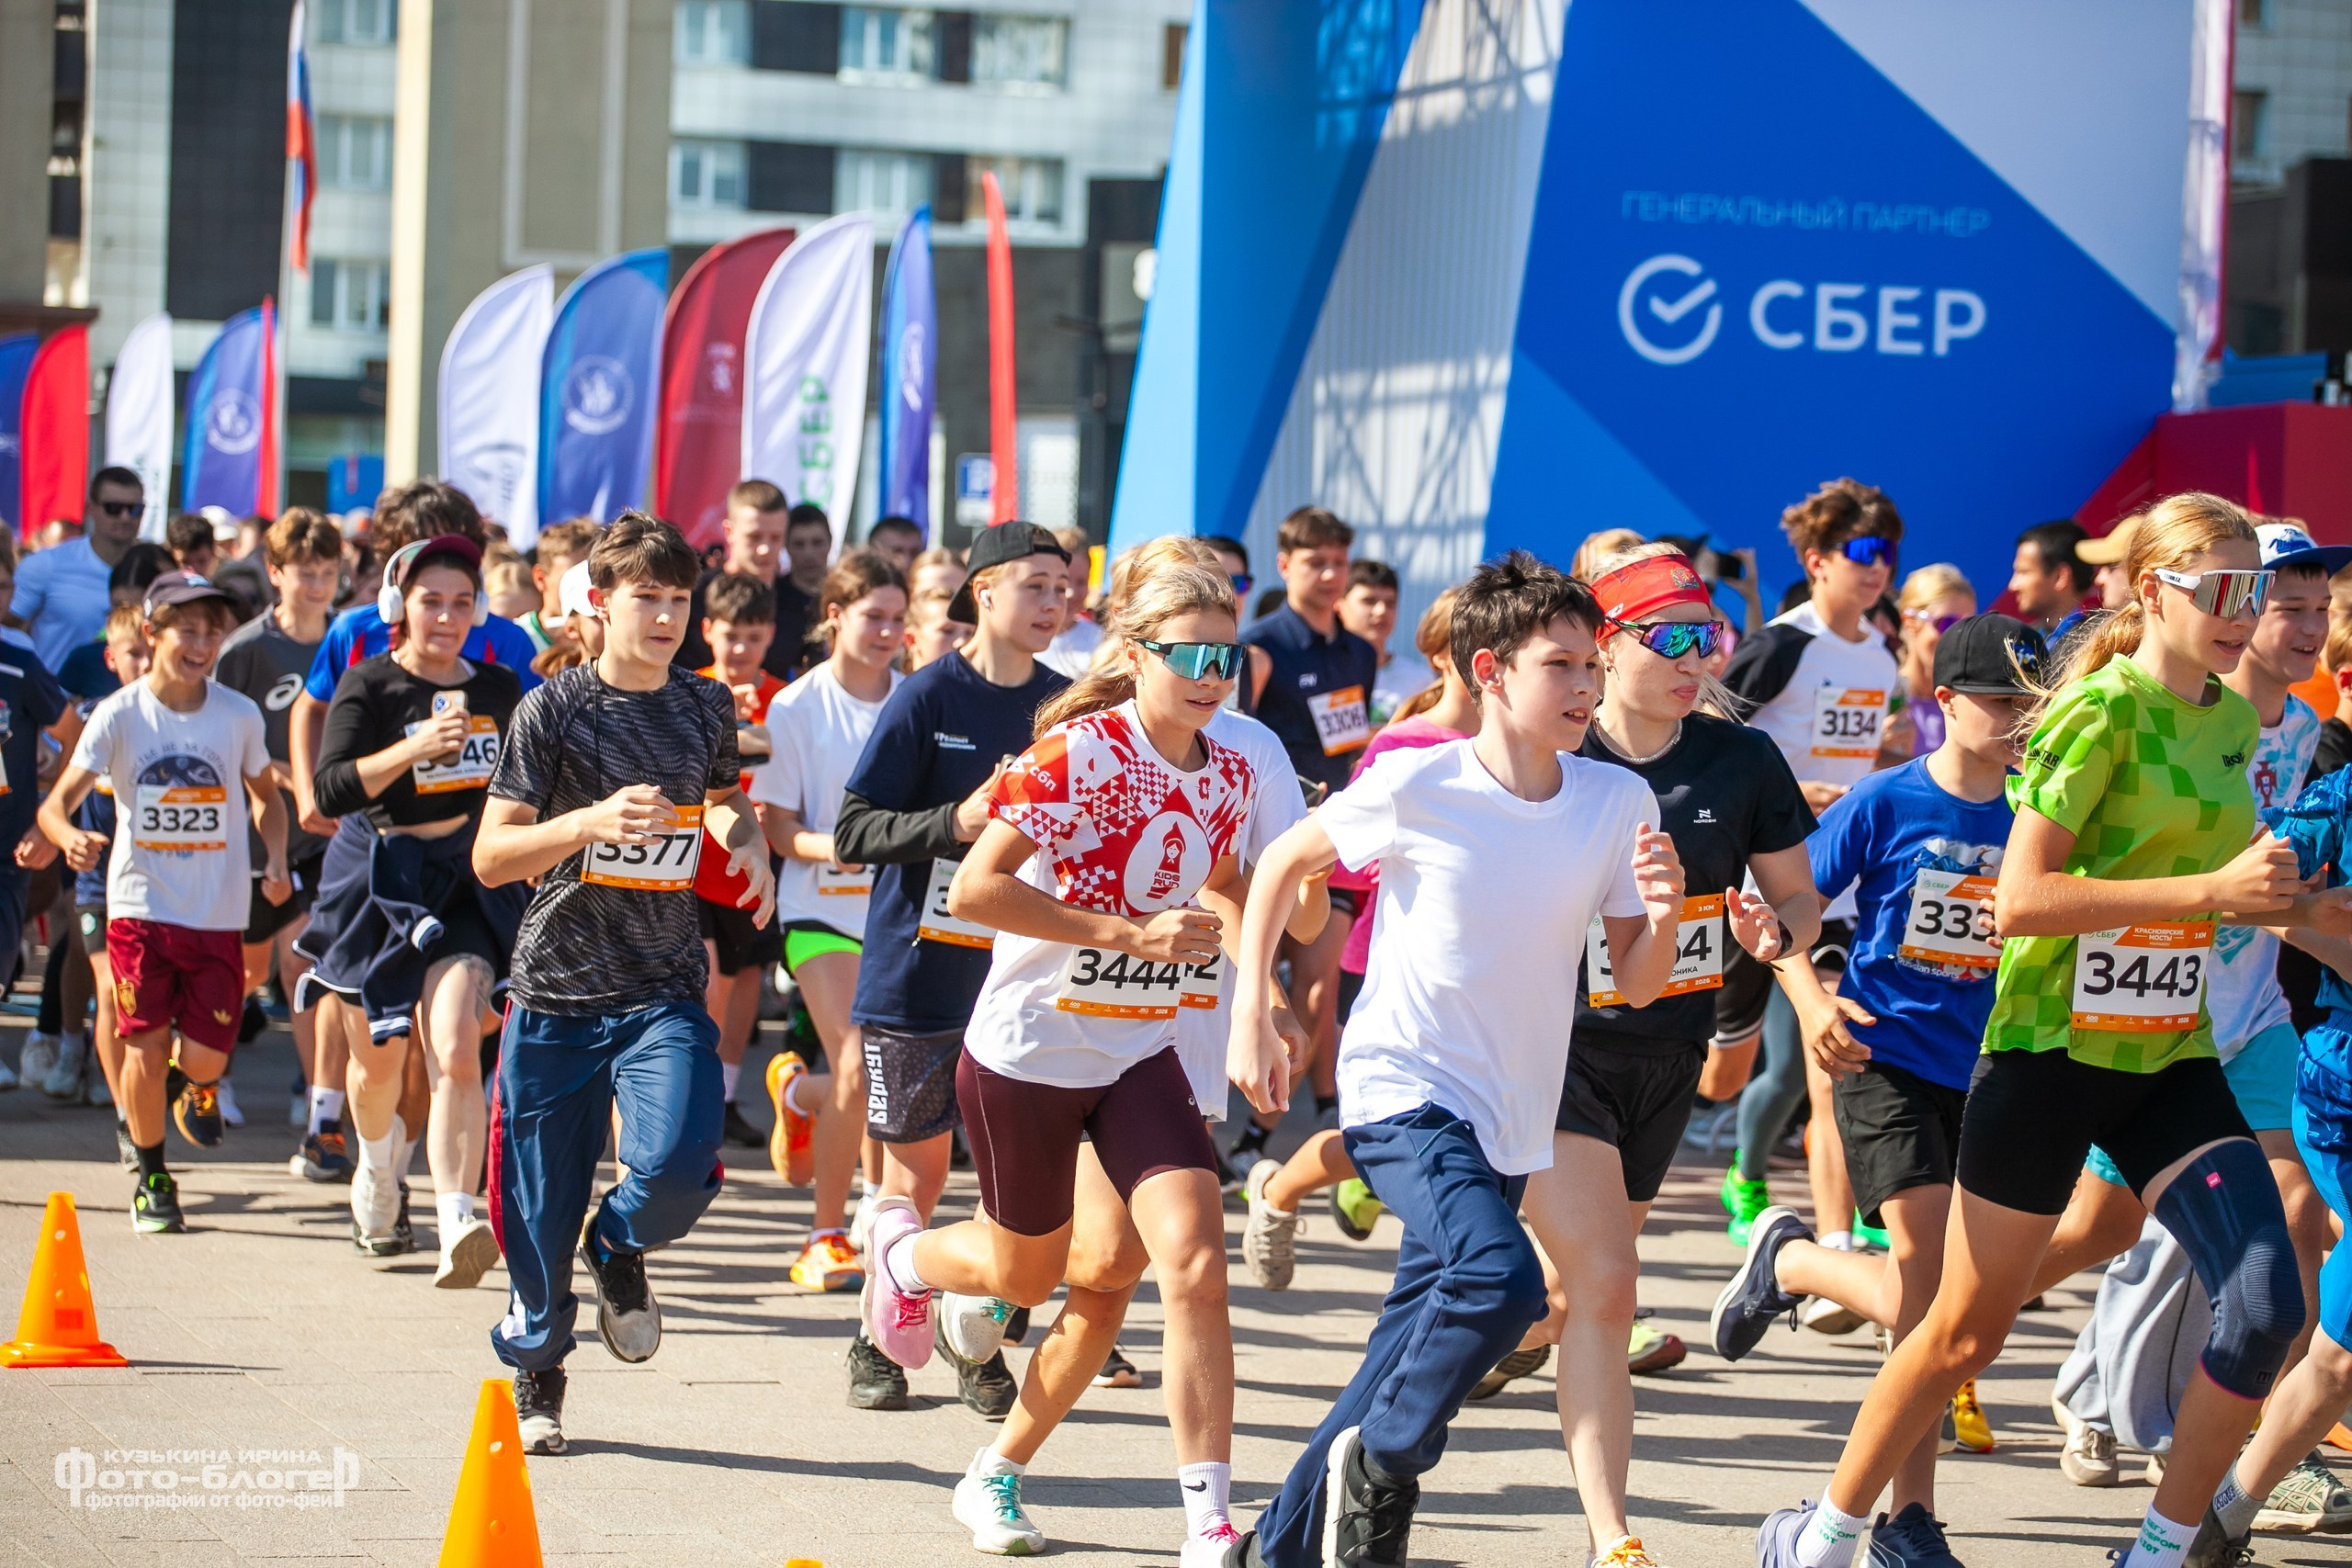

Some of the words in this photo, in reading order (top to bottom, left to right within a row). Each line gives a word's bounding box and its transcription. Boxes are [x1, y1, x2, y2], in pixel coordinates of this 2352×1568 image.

[1622, 188, 1848, 230] ГЕНЕРАЛЬНЫЙ
[1852, 201, 1992, 237] ПАРТНЕР
[1749, 279, 1987, 357] СБЕР
[798, 375, 833, 509] СБЕР
[1821, 708, 1876, 736] 3134
[1029, 765, 1057, 792] сбп
[141, 807, 220, 831] 3323
[1154, 871, 1181, 882] KIDS
[1915, 900, 1999, 942] 333
[2134, 927, 2185, 935] КРАСНОЯРСКИЕ
[1070, 949, 1181, 990] 3444
[1671, 965, 1698, 976] ОНИКА
[1897, 957, 1930, 974] Russian
[1931, 967, 1959, 979] sports
[2084, 952, 2201, 998] 3443
